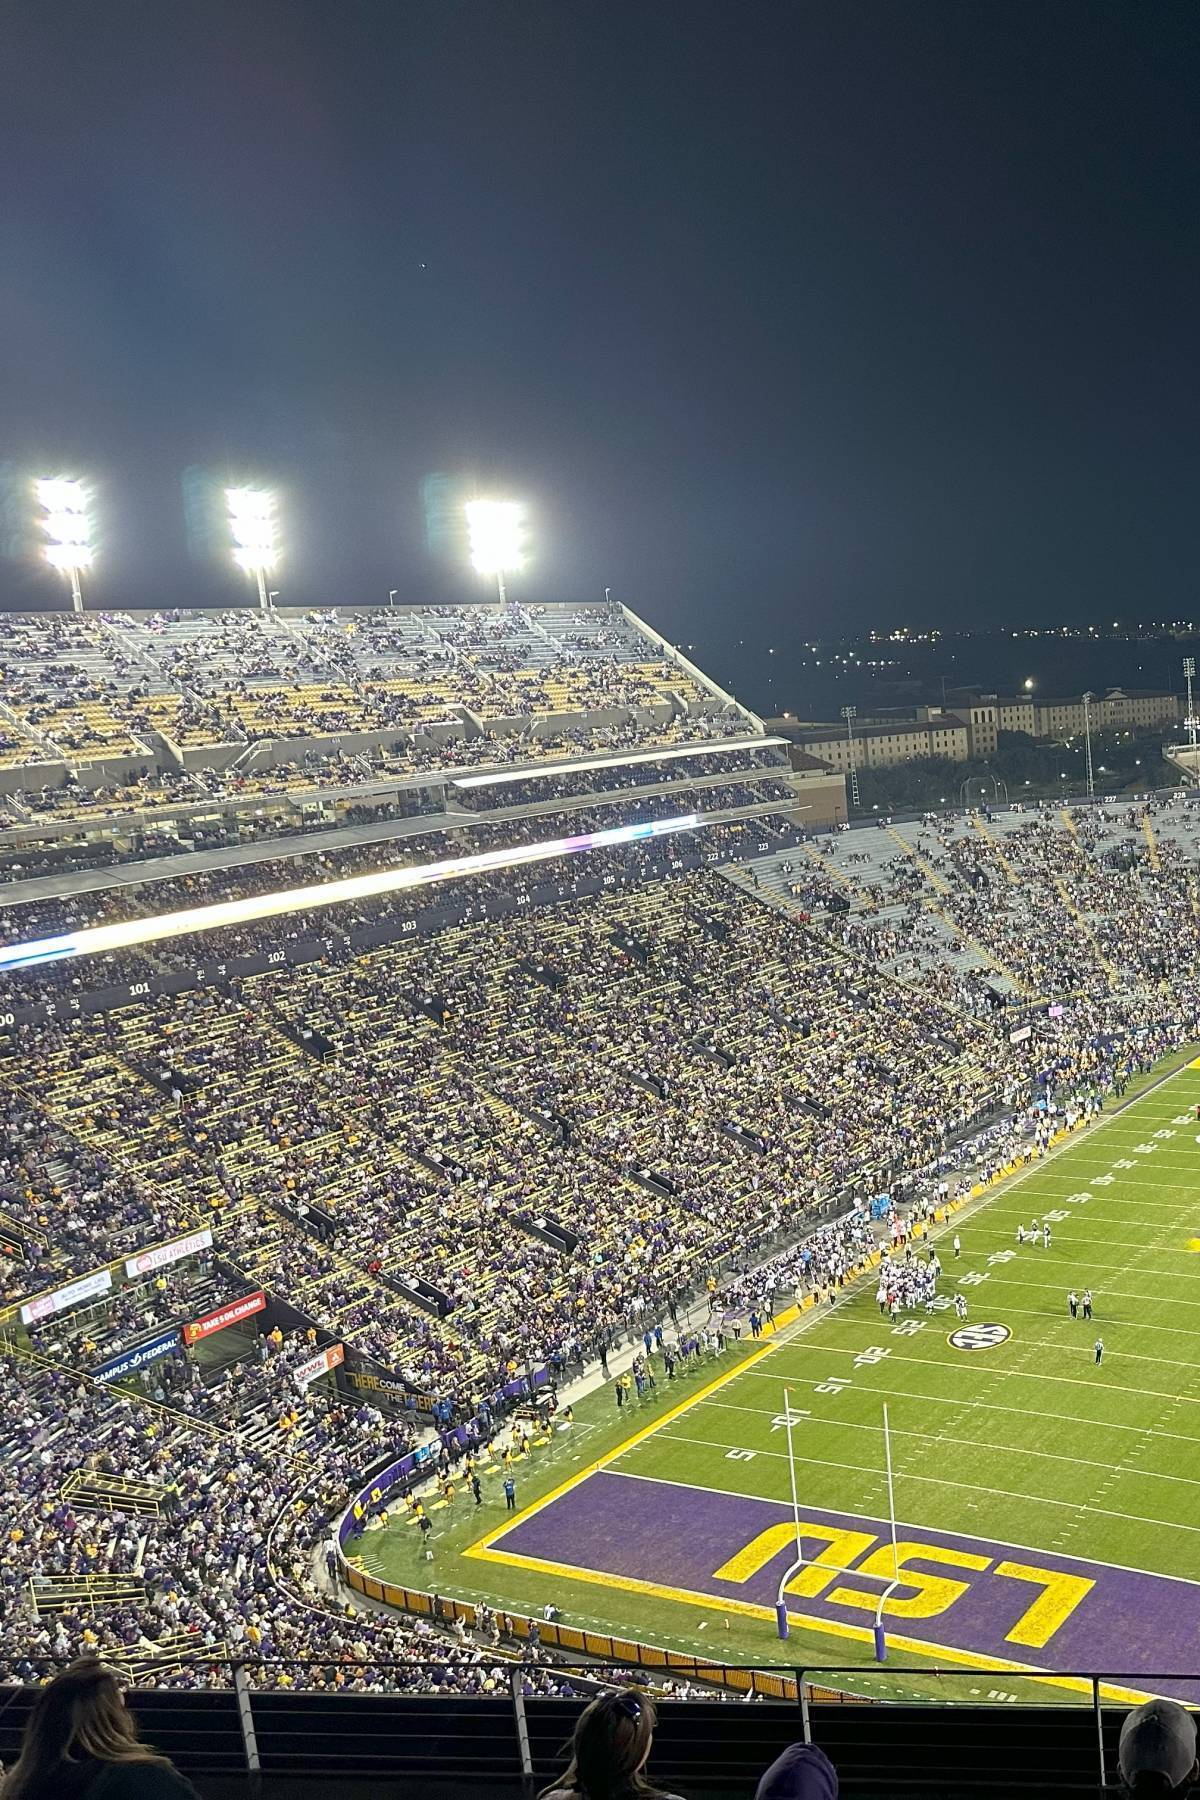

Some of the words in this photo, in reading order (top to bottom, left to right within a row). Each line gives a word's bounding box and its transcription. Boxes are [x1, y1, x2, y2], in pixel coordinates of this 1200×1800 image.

[758, 842, 768, 852] 223
[707, 852, 718, 862] 222
[672, 861, 682, 870] 106
[603, 876, 615, 886] 105
[516, 896, 530, 906] 104
[402, 920, 416, 932] 103
[268, 951, 286, 964] 102
[129, 982, 150, 996] 101
[1042, 1210, 1072, 1222] 50
[957, 1271, 991, 1286] 35
[202, 1318, 220, 1330] TAKE
[224, 1310, 234, 1320] OIL
[234, 1298, 262, 1316] CHANGE
[891, 1320, 928, 1336] 25
[94, 1362, 129, 1384] CAMPUS
[142, 1339, 177, 1362] FEDERAL
[853, 1346, 892, 1364] 20
[296, 1360, 324, 1378] WWL
[355, 1373, 380, 1391] HERE
[380, 1380, 406, 1392] COME
[814, 1376, 852, 1395] 15
[384, 1393, 403, 1404] THE
[770, 1407, 812, 1427] 10
[724, 1450, 758, 1462] 5
[712, 1521, 1096, 1648] LSU
